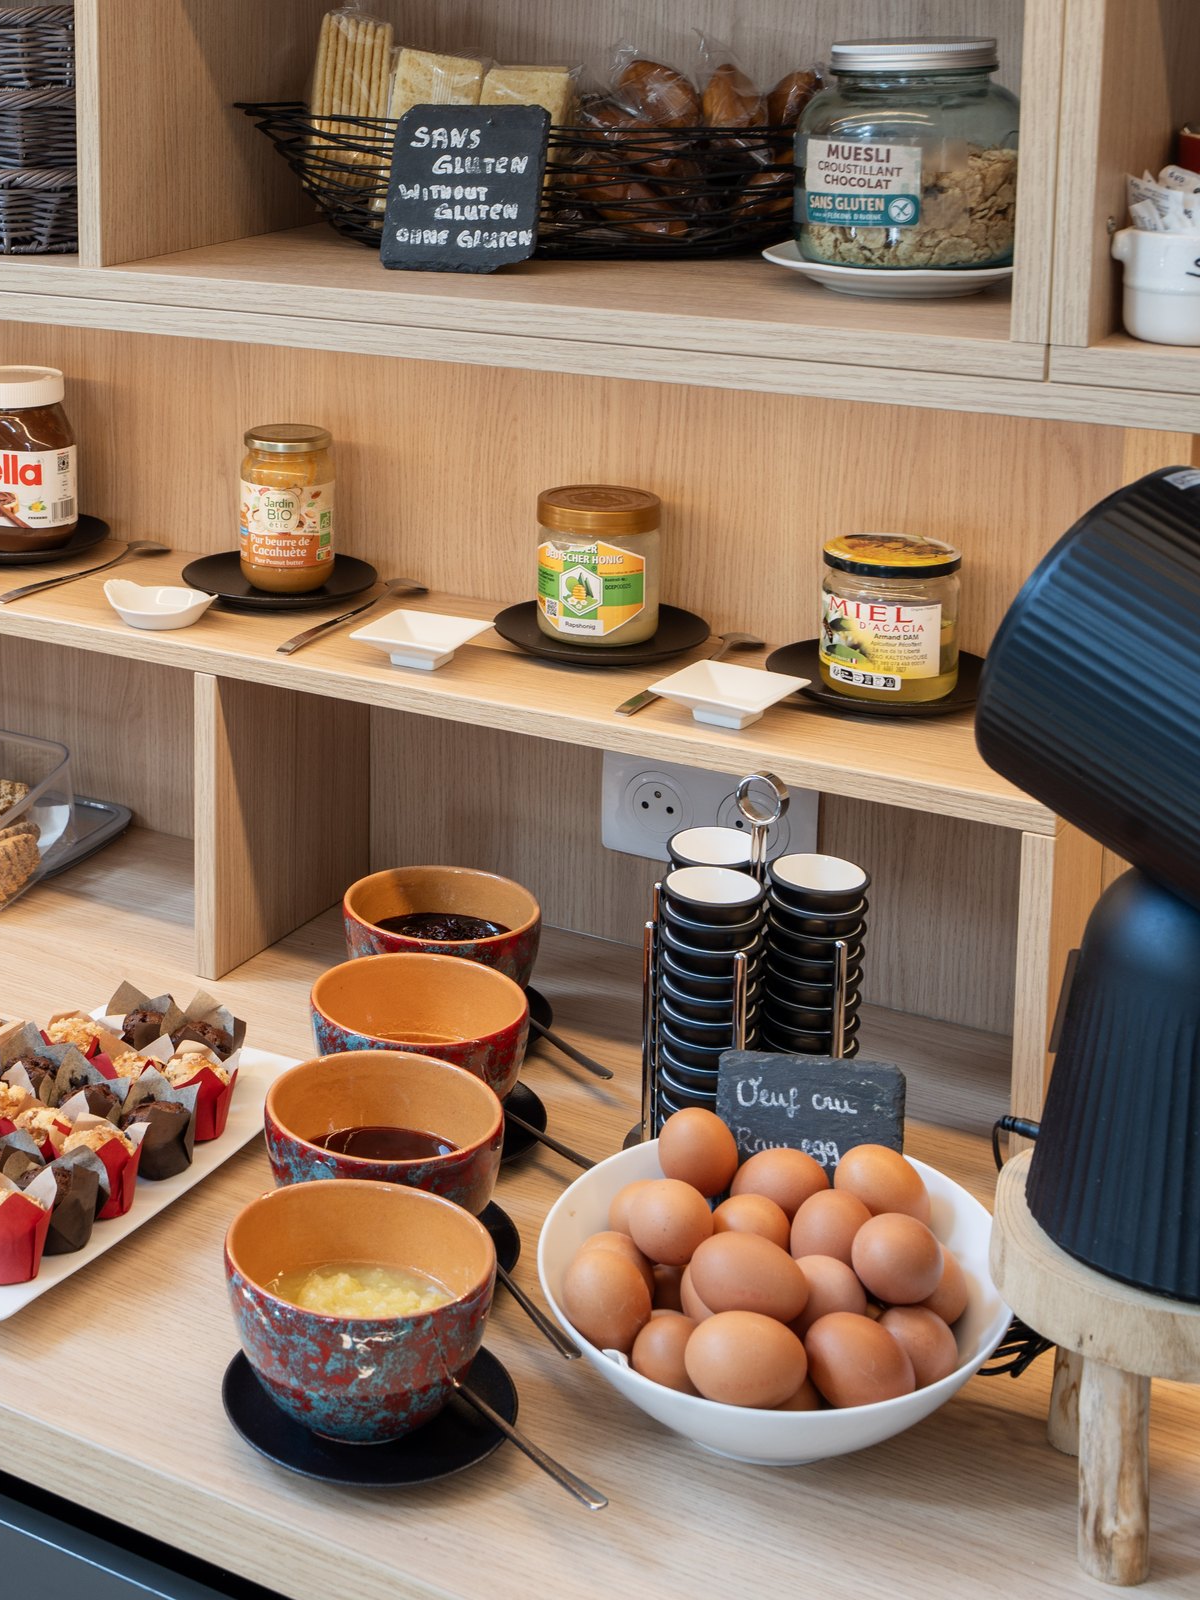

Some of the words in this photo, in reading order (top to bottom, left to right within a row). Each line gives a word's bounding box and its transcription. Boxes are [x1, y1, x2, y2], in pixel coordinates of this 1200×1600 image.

[409, 126, 481, 149] SANS
[826, 144, 891, 163] MUESLI
[817, 160, 903, 177] CROUSTILLANT
[824, 174, 892, 190] CHOCOLAT
[810, 195, 833, 210] SANS
[834, 197, 885, 211] GLUTEN
[264, 497, 294, 508] Jardin
[250, 534, 265, 544] Pur
[265, 536, 297, 546] beurre
[298, 537, 310, 546] de
[252, 544, 307, 557] Cacahuète
[592, 554, 625, 565] HONIG
[829, 595, 914, 624] MIEL
[564, 620, 596, 631] Rapshonig
[859, 621, 925, 633] D'ACACIA
[873, 633, 901, 641] Armand
[811, 1093, 858, 1115] cru
